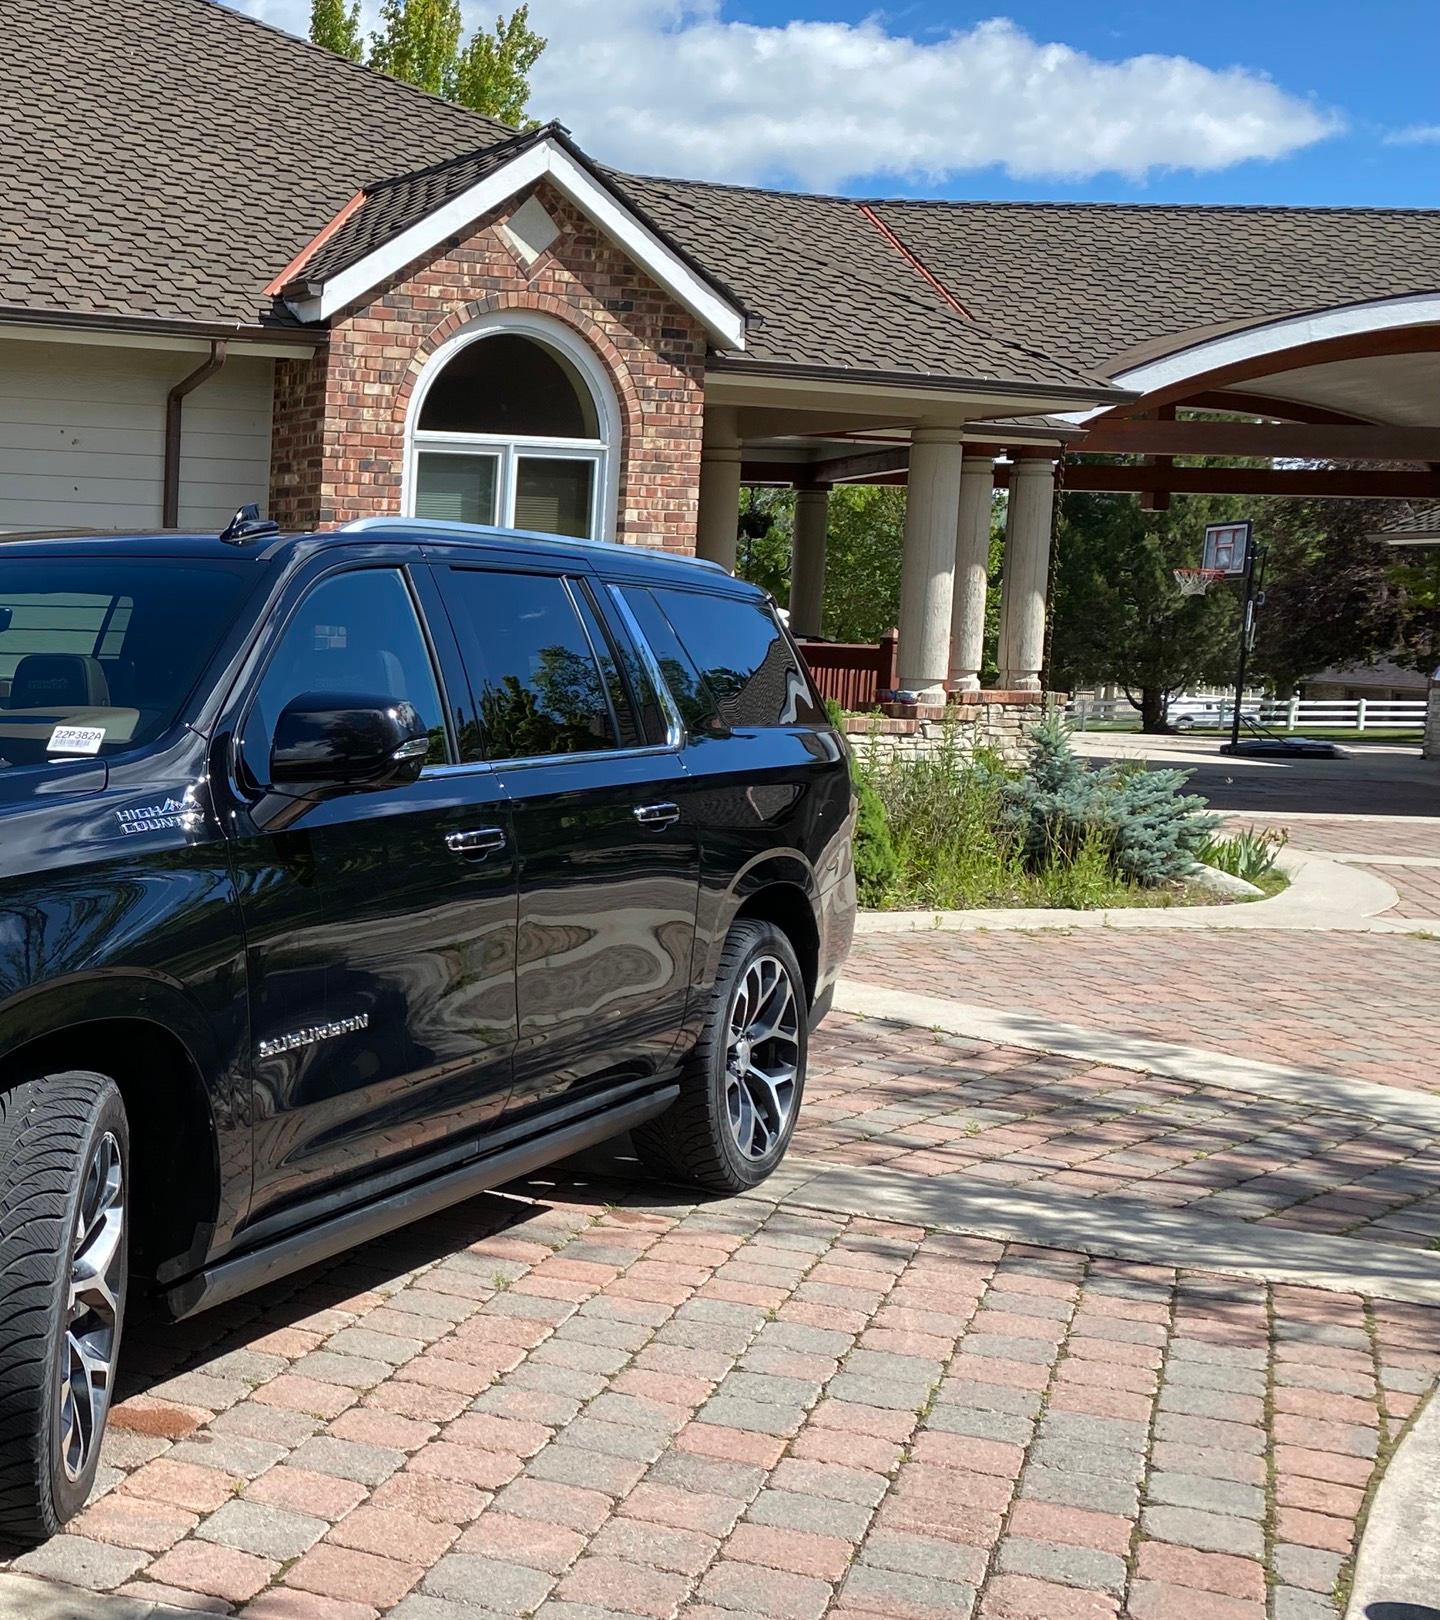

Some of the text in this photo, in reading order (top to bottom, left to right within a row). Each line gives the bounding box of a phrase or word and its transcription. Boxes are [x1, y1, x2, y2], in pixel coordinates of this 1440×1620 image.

[55, 730, 101, 741] 22P382A
[115, 805, 163, 824] HIGH
[260, 1013, 369, 1058] SUBURBAN
